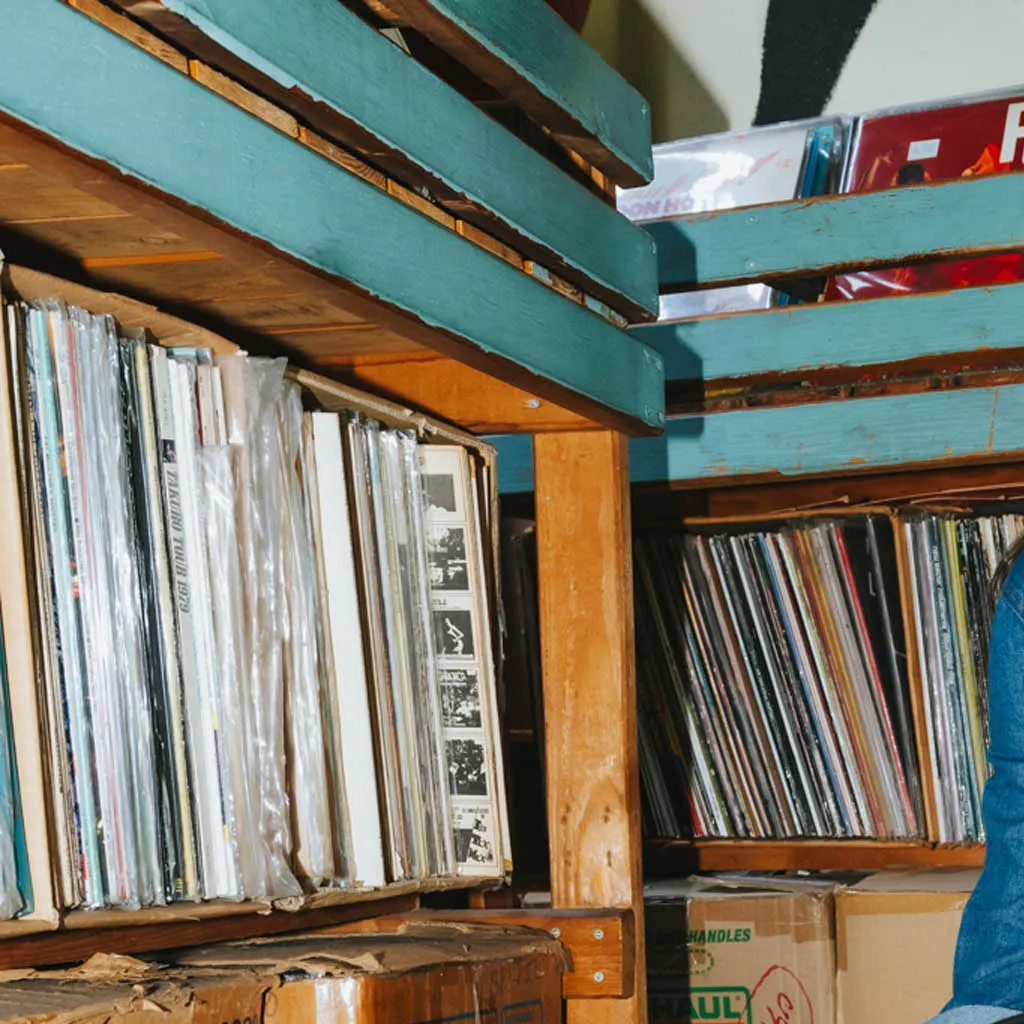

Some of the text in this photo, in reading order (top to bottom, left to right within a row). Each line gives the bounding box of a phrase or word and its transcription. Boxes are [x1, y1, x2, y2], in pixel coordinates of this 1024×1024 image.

[165, 470, 191, 614] TAKURO TOUR 1979
[688, 928, 751, 944] HANDLES
